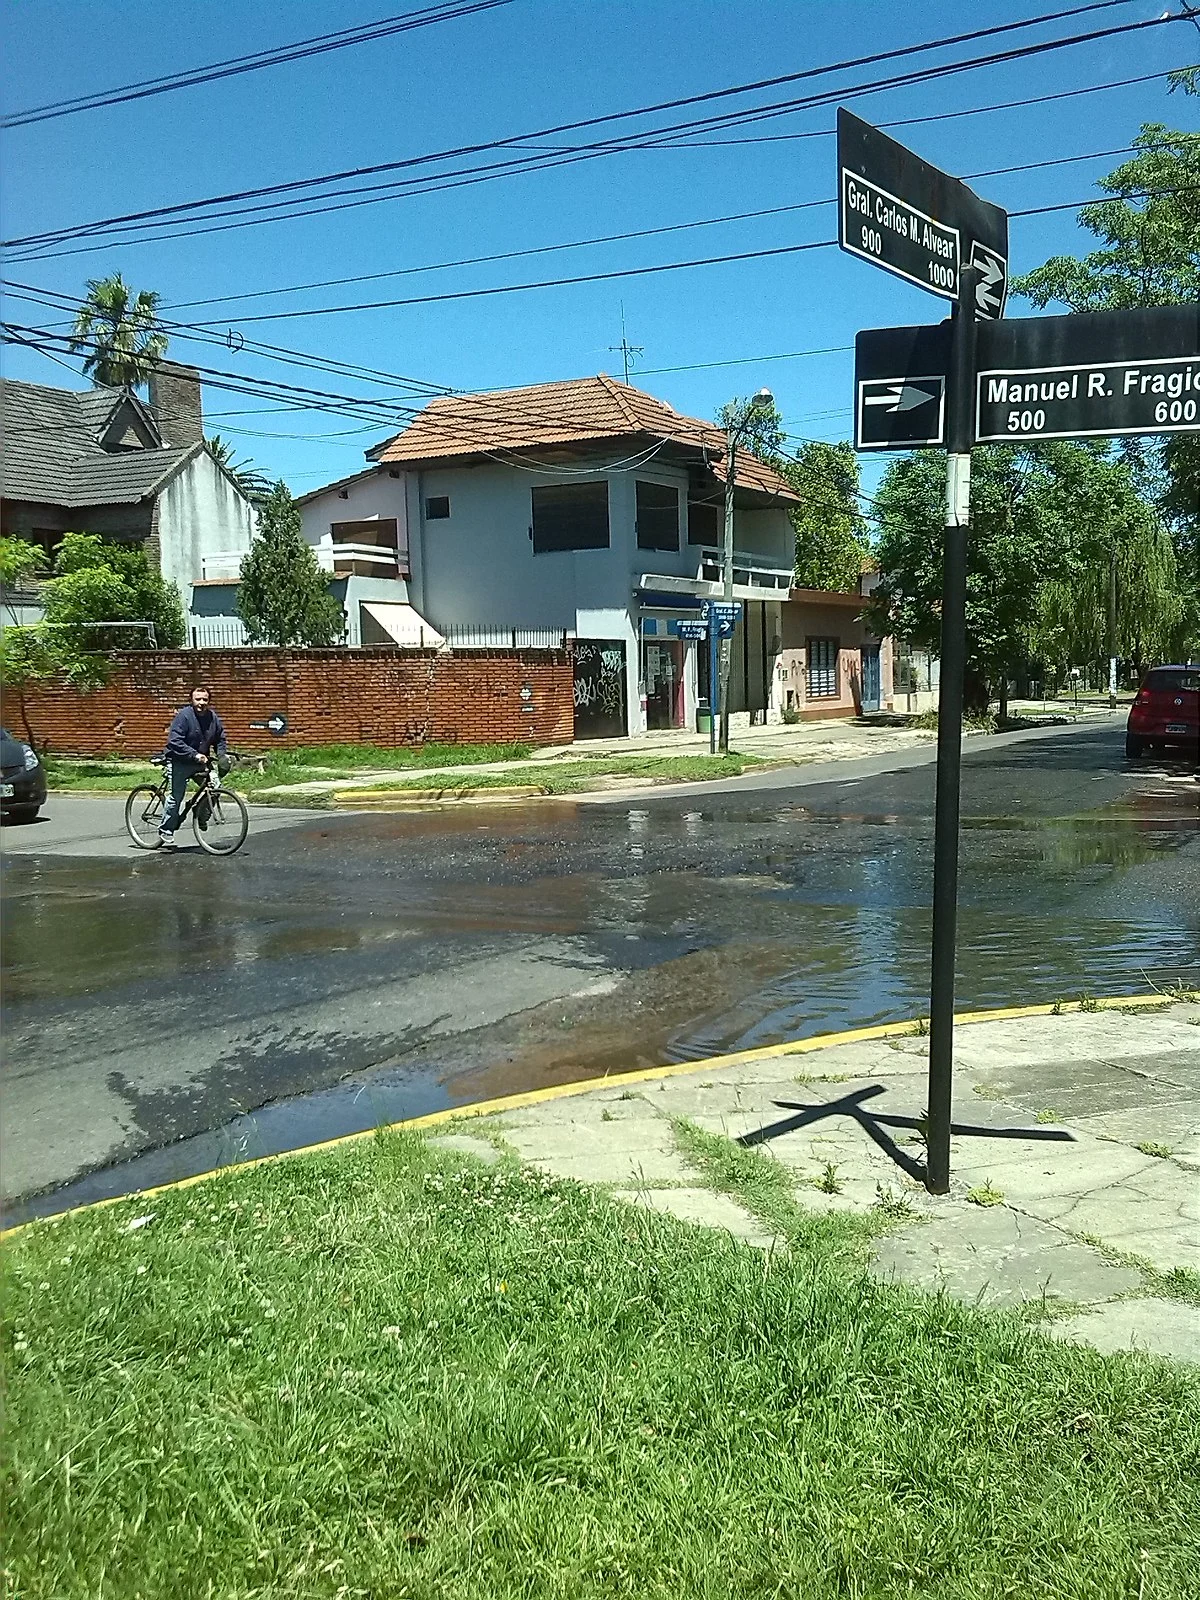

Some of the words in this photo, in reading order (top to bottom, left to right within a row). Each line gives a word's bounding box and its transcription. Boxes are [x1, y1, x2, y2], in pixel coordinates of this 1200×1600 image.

[848, 181, 873, 219] Gral.
[875, 196, 908, 237] Carlos
[909, 215, 921, 244] M.
[922, 223, 954, 259] Alvear
[861, 225, 882, 255] 900
[928, 260, 955, 289] 1000
[987, 374, 1078, 403] Manuel
[1087, 372, 1113, 398] R.
[1007, 409, 1046, 431] 500
[1154, 400, 1197, 423] 600
